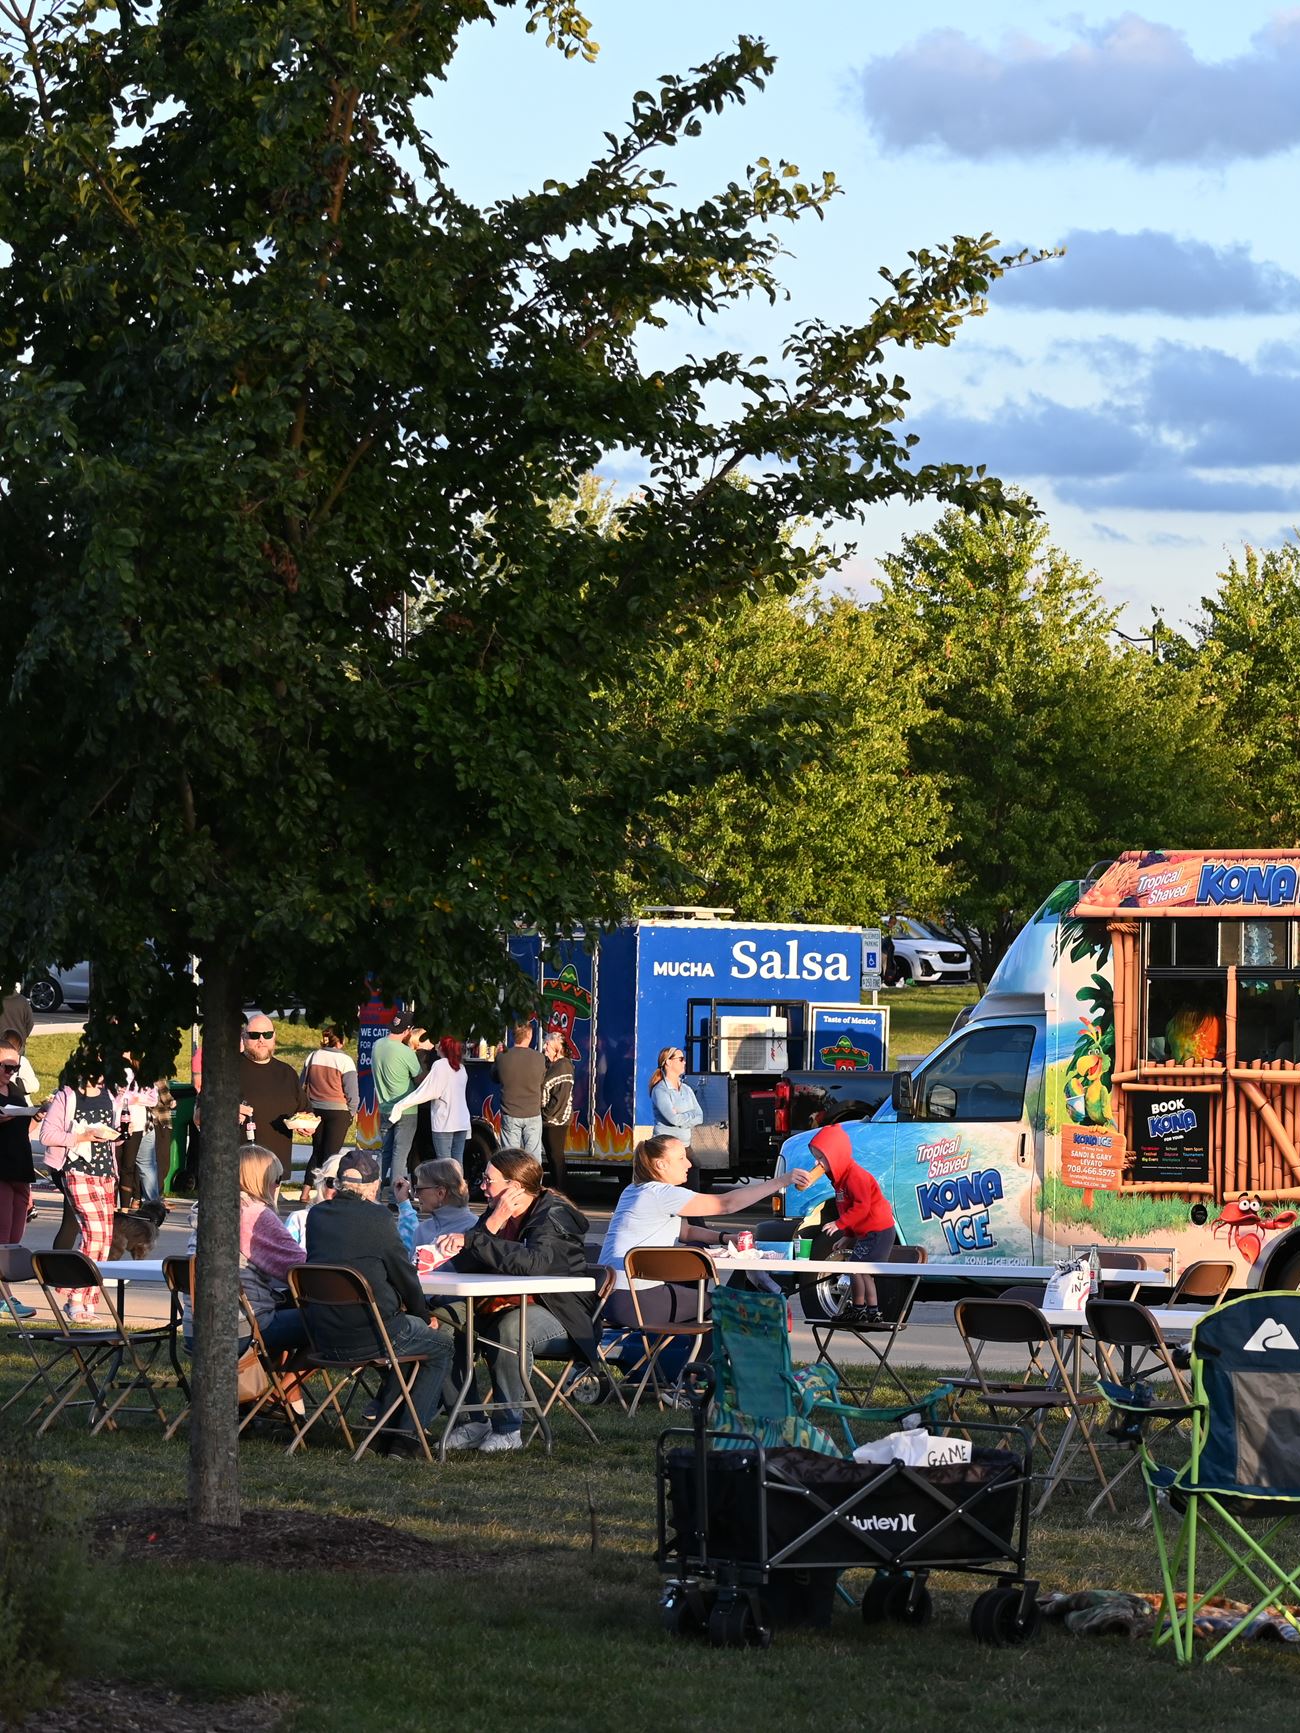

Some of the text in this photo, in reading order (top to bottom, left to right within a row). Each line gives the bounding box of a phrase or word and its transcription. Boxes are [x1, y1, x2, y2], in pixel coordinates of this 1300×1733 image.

[1137, 867, 1184, 892] Tropical
[1196, 864, 1298, 906] KONA
[1148, 880, 1190, 904] Shaved
[653, 939, 851, 981] MUCHA Salsa
[360, 1028, 372, 1036] WE
[1151, 1098, 1186, 1114] BOOK
[1148, 1109, 1198, 1138] KONA
[917, 1135, 960, 1162] Tropical
[1073, 1133, 1113, 1148] KONA ICE
[928, 1152, 969, 1178] Shaved
[1071, 1150, 1090, 1158] SANDI
[1096, 1153, 1112, 1161] GARY
[1080, 1159, 1102, 1168] LEVATO
[1067, 1164, 1116, 1177] 708.466.5575
[916, 1168, 1004, 1222] KONA
[941, 1209, 994, 1256] ICE
[964, 1256, 1029, 1266] KONA-ICE.COM
[928, 1444, 968, 1467] GAME
